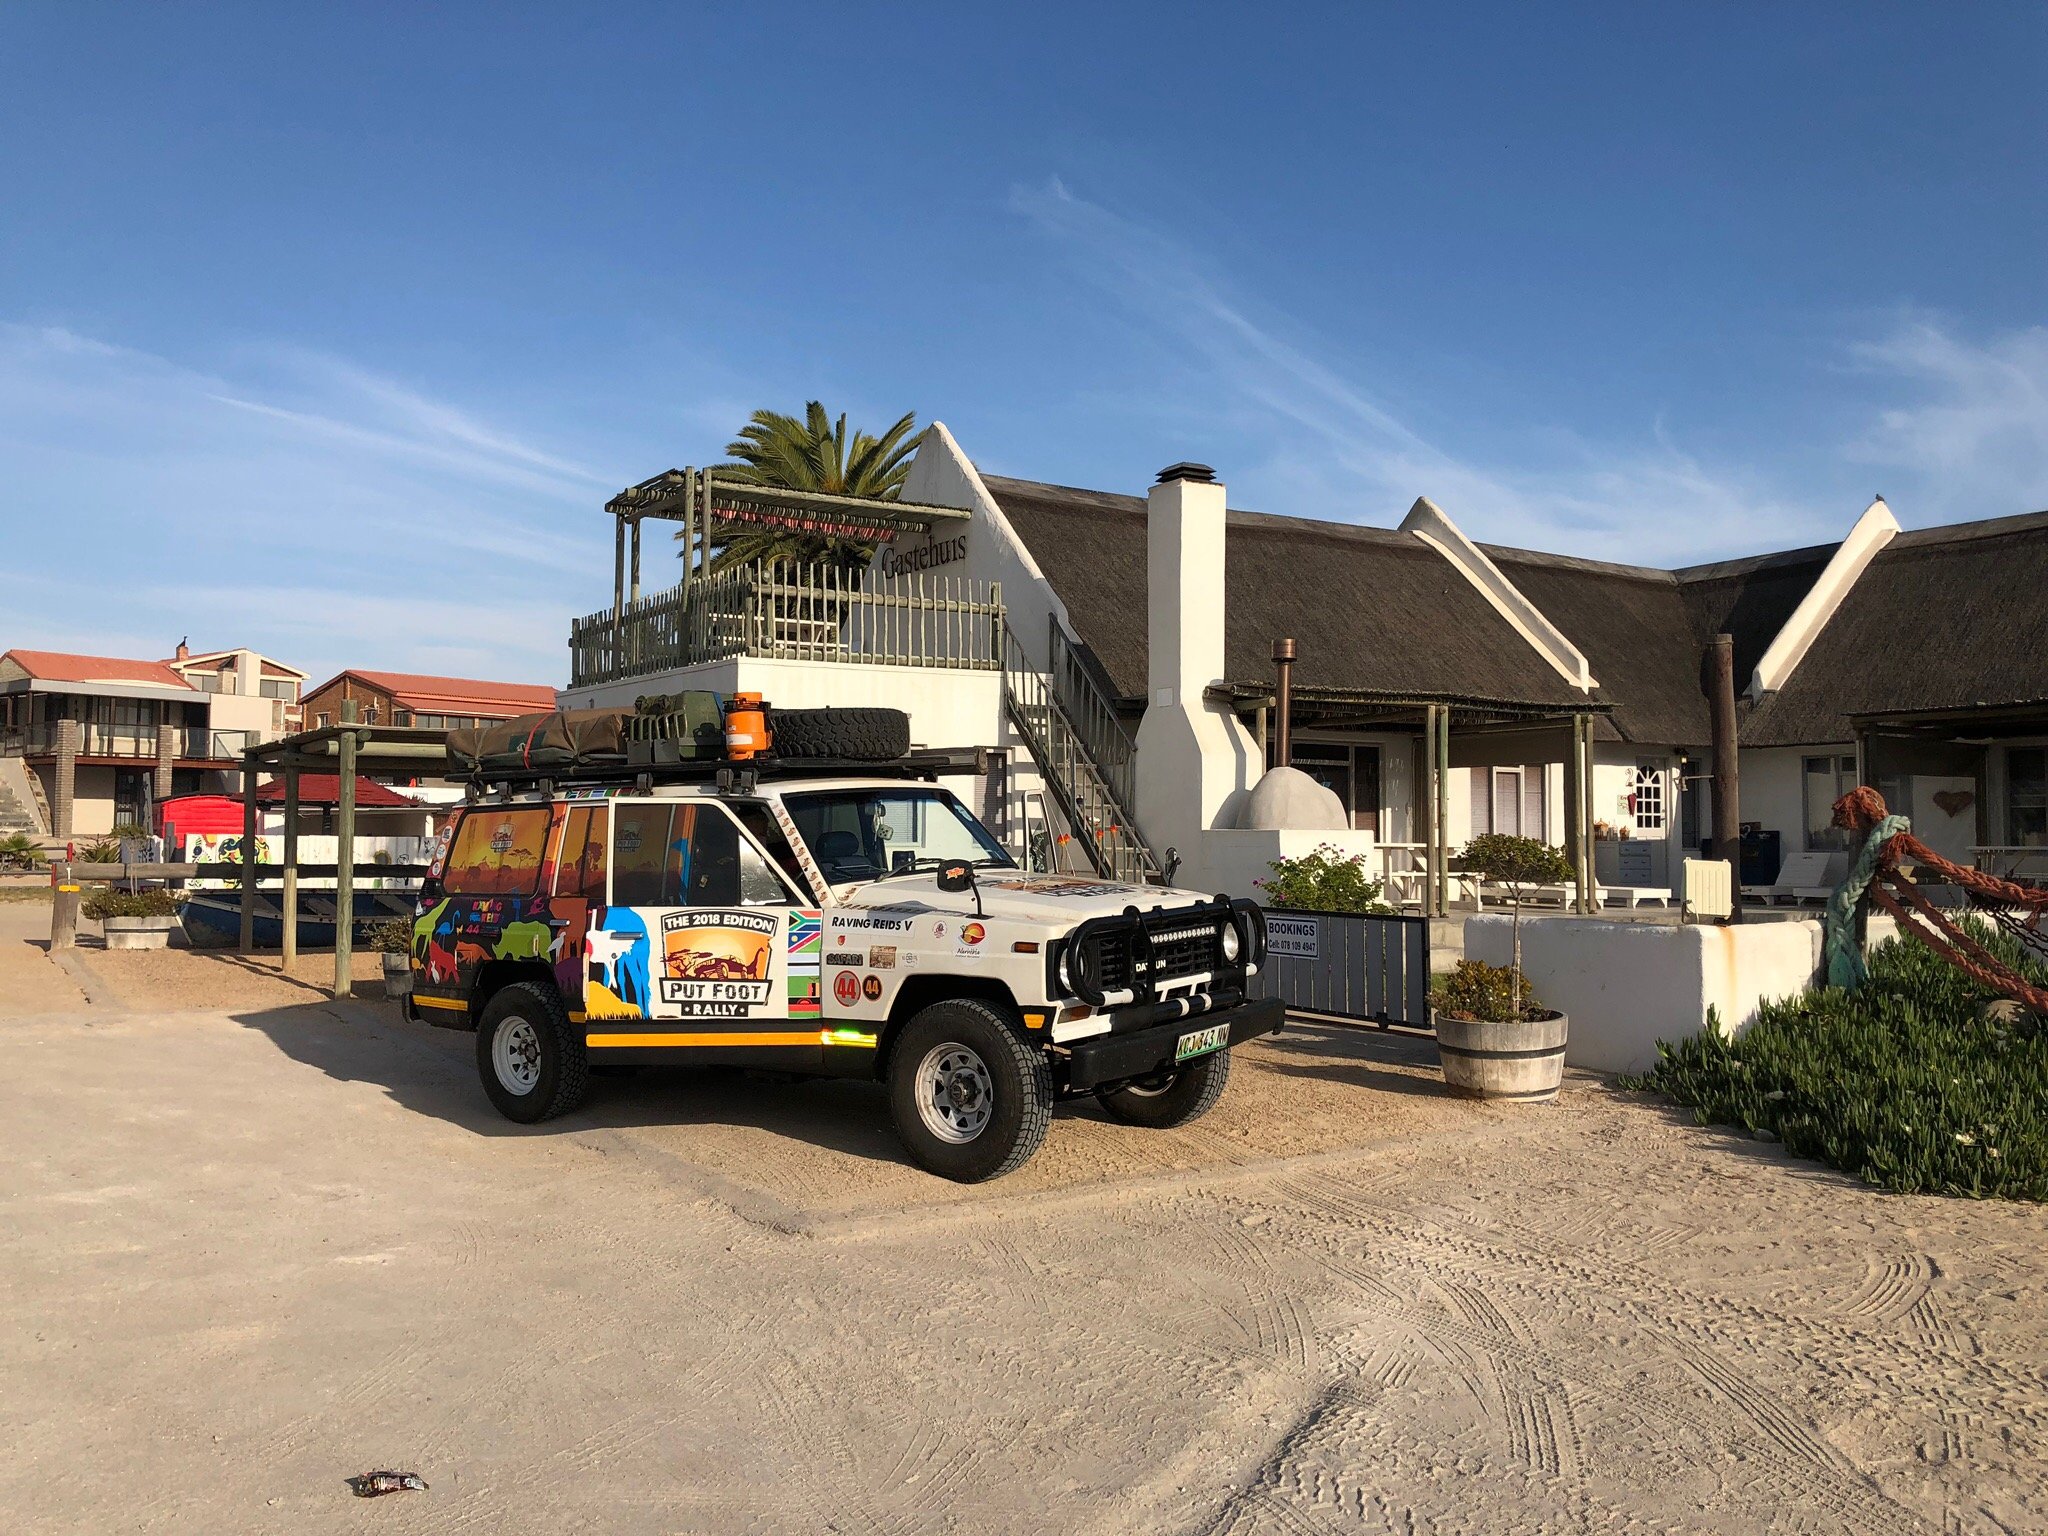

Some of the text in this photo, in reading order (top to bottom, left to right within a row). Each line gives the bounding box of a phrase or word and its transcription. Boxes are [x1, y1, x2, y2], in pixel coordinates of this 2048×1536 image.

[881, 534, 966, 580] Gastehuis
[665, 914, 774, 932] THE 2018 EDITION
[832, 916, 913, 932] RAVING REIDS V
[1268, 922, 1315, 937] BOOKINGS
[1280, 940, 1291, 950] 078
[1302, 942, 1316, 952] 4947
[827, 953, 863, 966] SAFARI
[1135, 959, 1167, 973] DAUN
[669, 982, 762, 1000] PUT FOOT
[837, 977, 880, 1000] 44 44
[692, 1003, 738, 1016] RALLY
